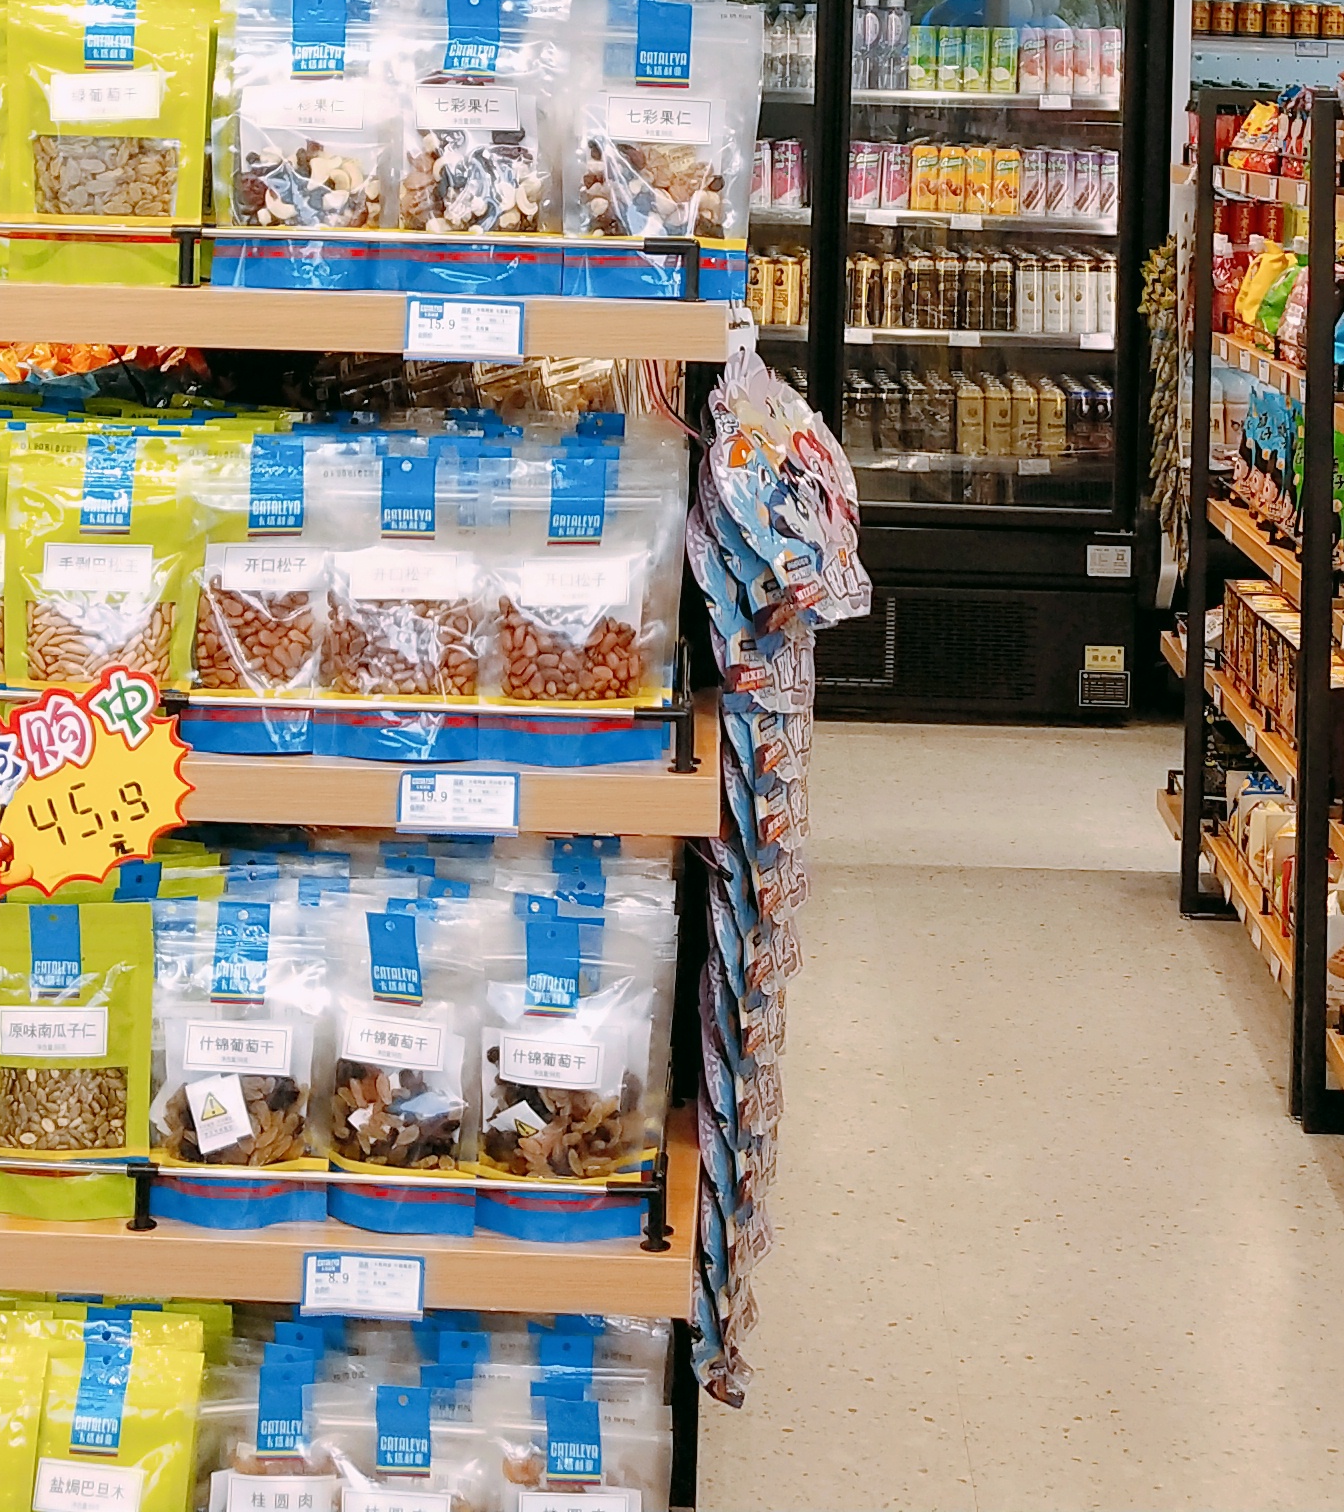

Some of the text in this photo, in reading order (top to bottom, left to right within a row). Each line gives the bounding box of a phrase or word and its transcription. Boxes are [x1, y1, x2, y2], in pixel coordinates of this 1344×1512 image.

[433, 96, 501, 116] 七彩果仁
[624, 107, 694, 128] 七彩果仁
[56, 554, 141, 575] 手剥巴松王
[243, 555, 309, 575] 开口松子
[421, 791, 448, 803] 19.9
[7, 1021, 98, 1040] 原味南瓜子仁
[358, 1028, 429, 1052] 什锦葡萄干
[198, 1034, 276, 1055] 什锦葡萄干
[512, 1048, 588, 1070] 什锦葡萄干
[327, 1270, 350, 1285] 8.9
[379, 1435, 429, 1453] CATALEYA
[550, 1442, 600, 1459] CATALEYA
[47, 1476, 127, 1501] 盐焗巴旦木
[249, 1491, 316, 1511] 桂圆肉
